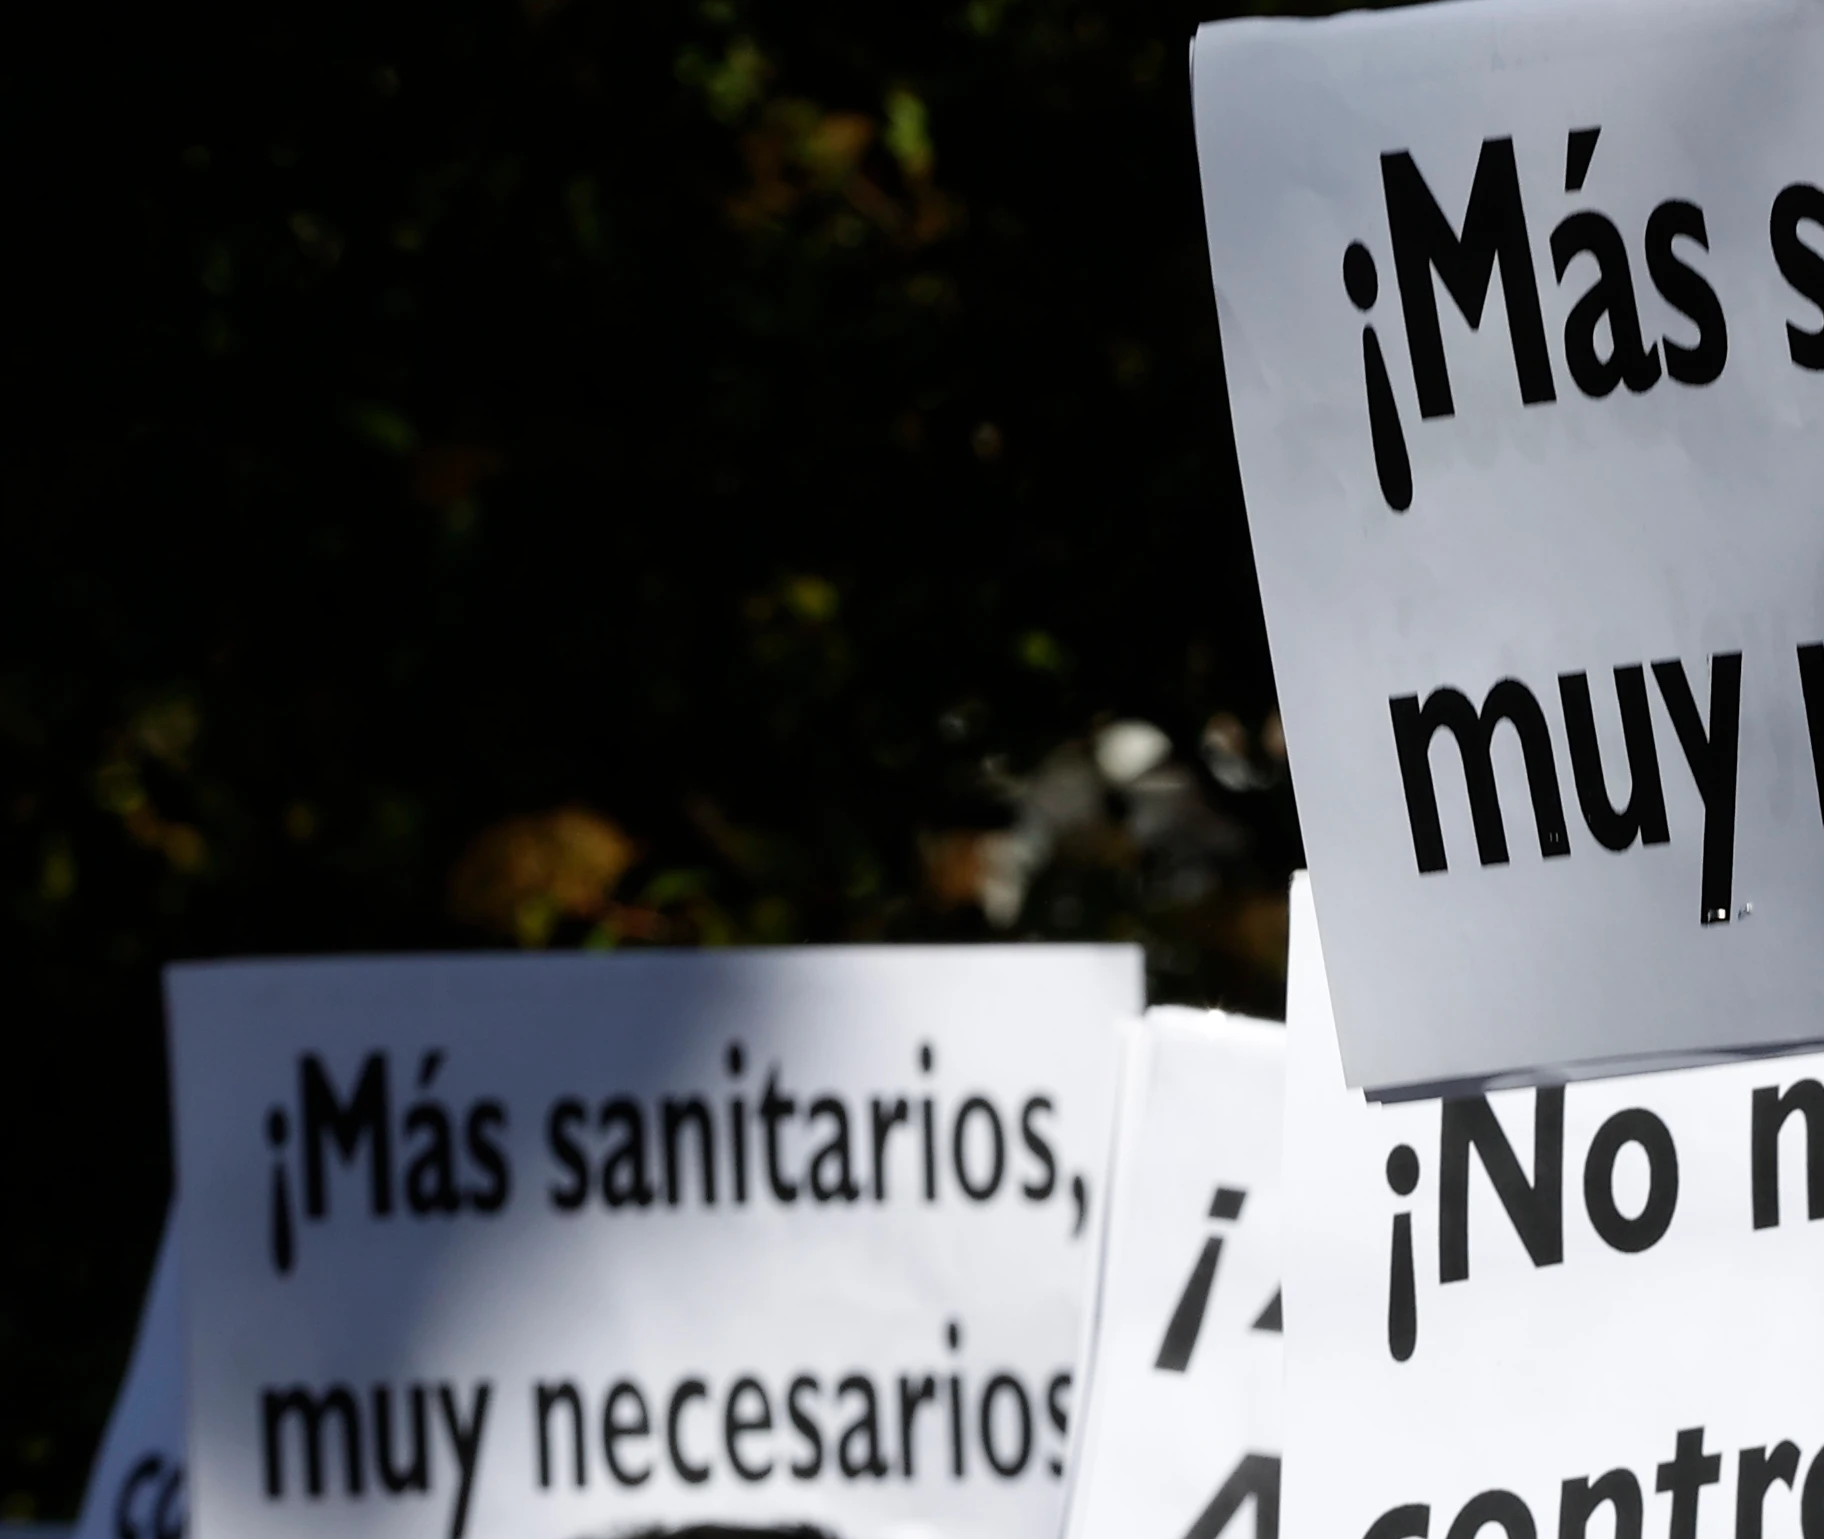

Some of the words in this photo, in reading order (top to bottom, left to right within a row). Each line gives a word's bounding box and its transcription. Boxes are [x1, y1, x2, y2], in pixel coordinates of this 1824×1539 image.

[1342, 126, 1728, 511] ¡Más
[1390, 651, 1743, 926] muy
[263, 1049, 511, 1277] ¡Más
[545, 1042, 1090, 1239] sanitarios,
[1386, 1084, 1679, 1363] ¡No
